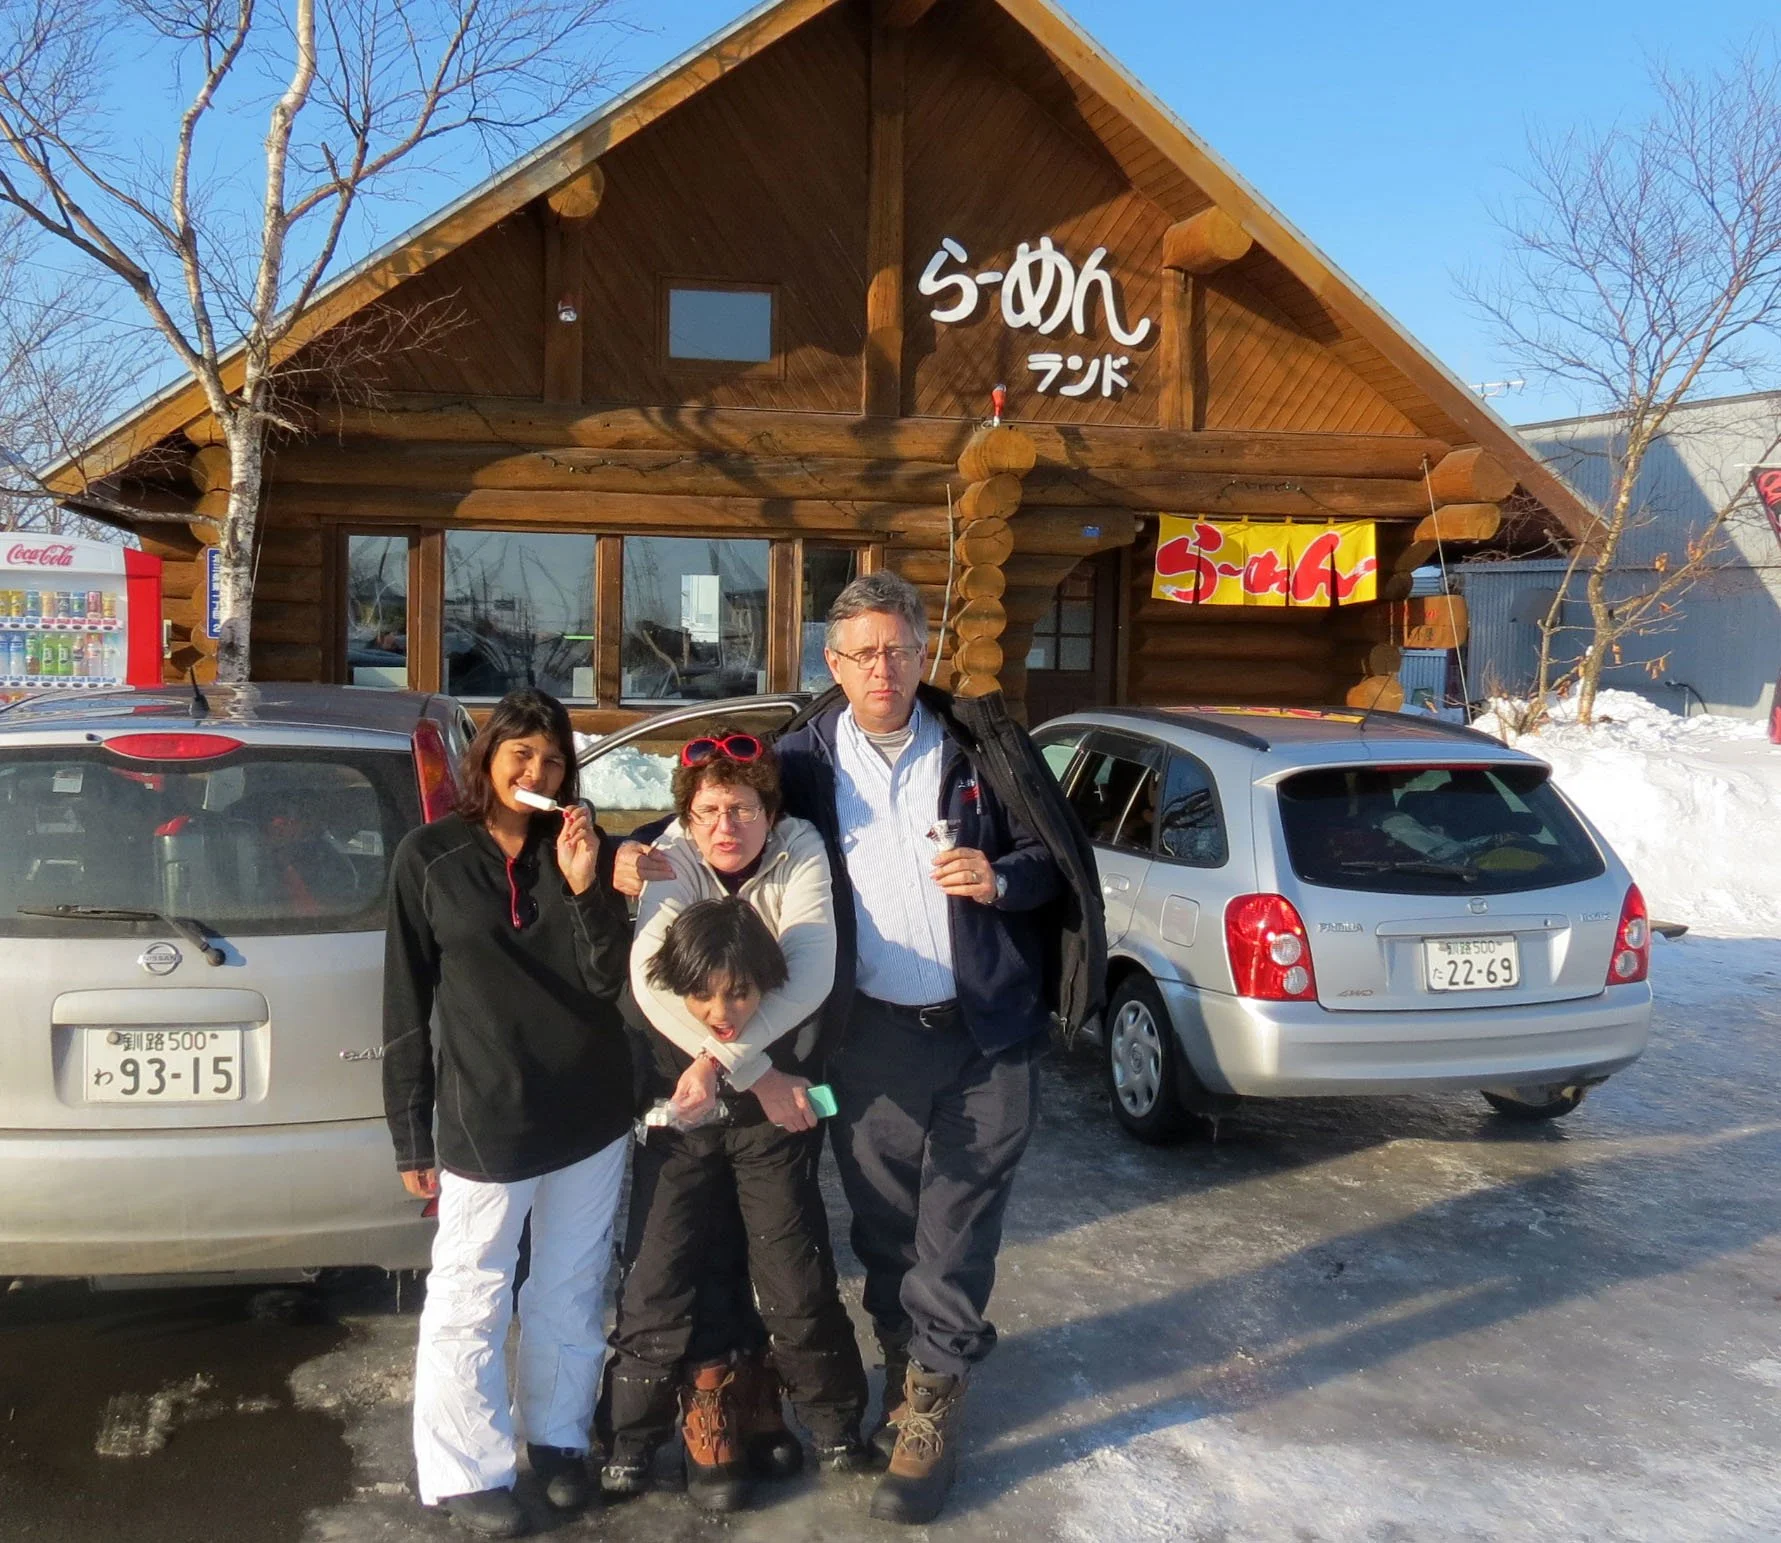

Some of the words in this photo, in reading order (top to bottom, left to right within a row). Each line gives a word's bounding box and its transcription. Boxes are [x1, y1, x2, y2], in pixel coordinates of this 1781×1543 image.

[918, 236, 1151, 346] らーめん
[1027, 353, 1129, 397] ランド
[6, 543, 76, 566] Coca-Cola
[1447, 957, 1513, 986] 22-69
[94, 1068, 114, 1086] わ
[120, 1056, 233, 1096] 93-15
